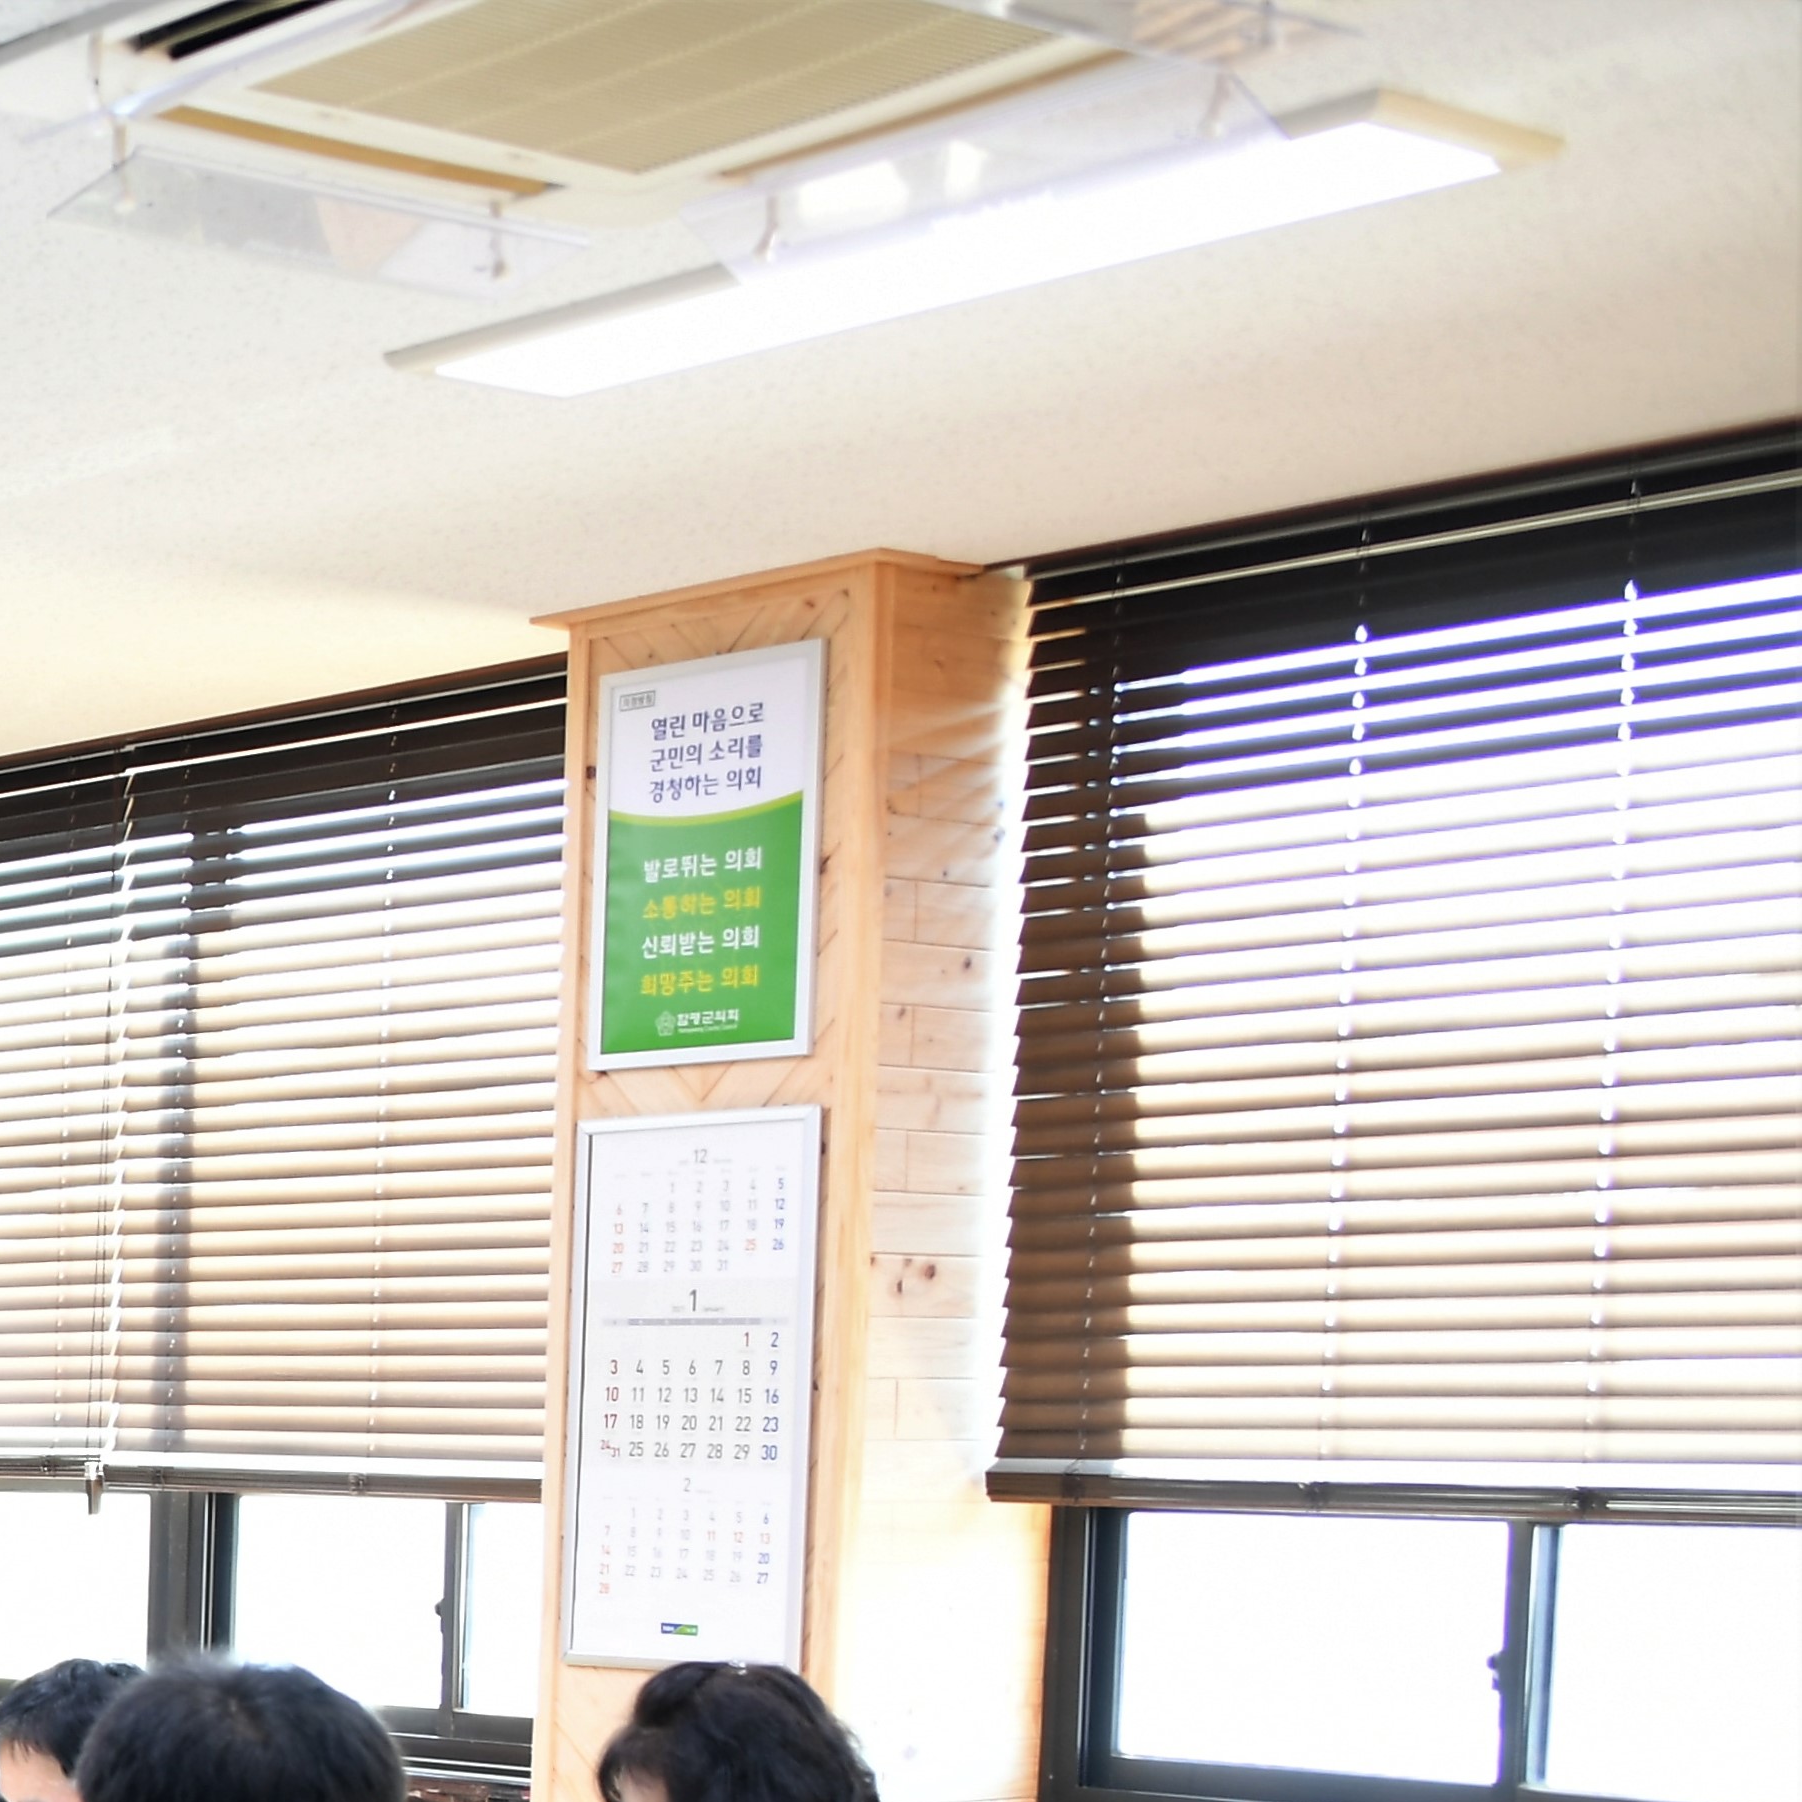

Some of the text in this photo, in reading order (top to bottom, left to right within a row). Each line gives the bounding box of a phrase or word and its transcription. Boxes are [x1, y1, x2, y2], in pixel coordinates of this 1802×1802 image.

[651, 702, 764, 741] 열린 마음으로
[650, 734, 762, 772] 군민의 소리를
[649, 765, 761, 803] 경청하는 의회
[644, 846, 762, 883] 발로뛰는 의회
[642, 886, 761, 920] 소통하는 의회
[642, 925, 760, 959] 신뢰받는 의회
[641, 964, 759, 996] 희망주는 의회
[693, 1147, 708, 1165] 12
[689, 1289, 698, 1313] 1
[744, 1331, 780, 1349] 1 2
[610, 1359, 778, 1376] 3 4 5 6 7 8 9
[605, 1386, 780, 1405] 10 11 12 13 14 15 16
[604, 1413, 779, 1433] 17 18 19 20 21 22 23
[628, 1441, 644, 1457] 25
[653, 1441, 670, 1459] 26
[679, 1442, 697, 1459] 27
[706, 1442, 724, 1460] 28
[733, 1443, 751, 1461] 29
[760, 1443, 778, 1461] 30
[682, 1477, 692, 1493] 2
